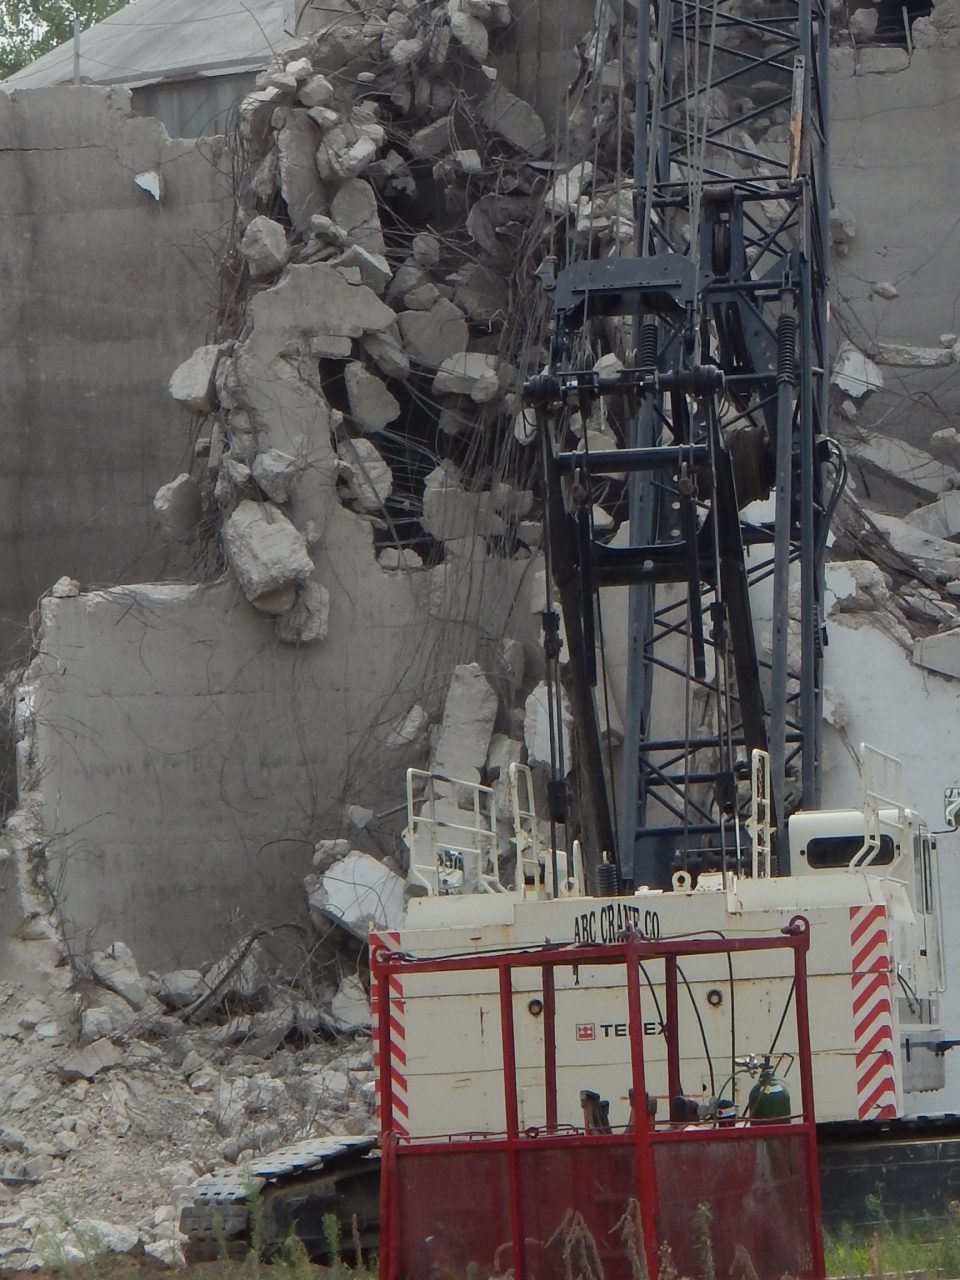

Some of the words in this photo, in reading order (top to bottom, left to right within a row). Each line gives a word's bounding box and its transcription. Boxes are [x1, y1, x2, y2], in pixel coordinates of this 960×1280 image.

[574, 910, 597, 943] ABC
[600, 903, 640, 944] CRANE
[600, 1022, 668, 1038] TEEX
